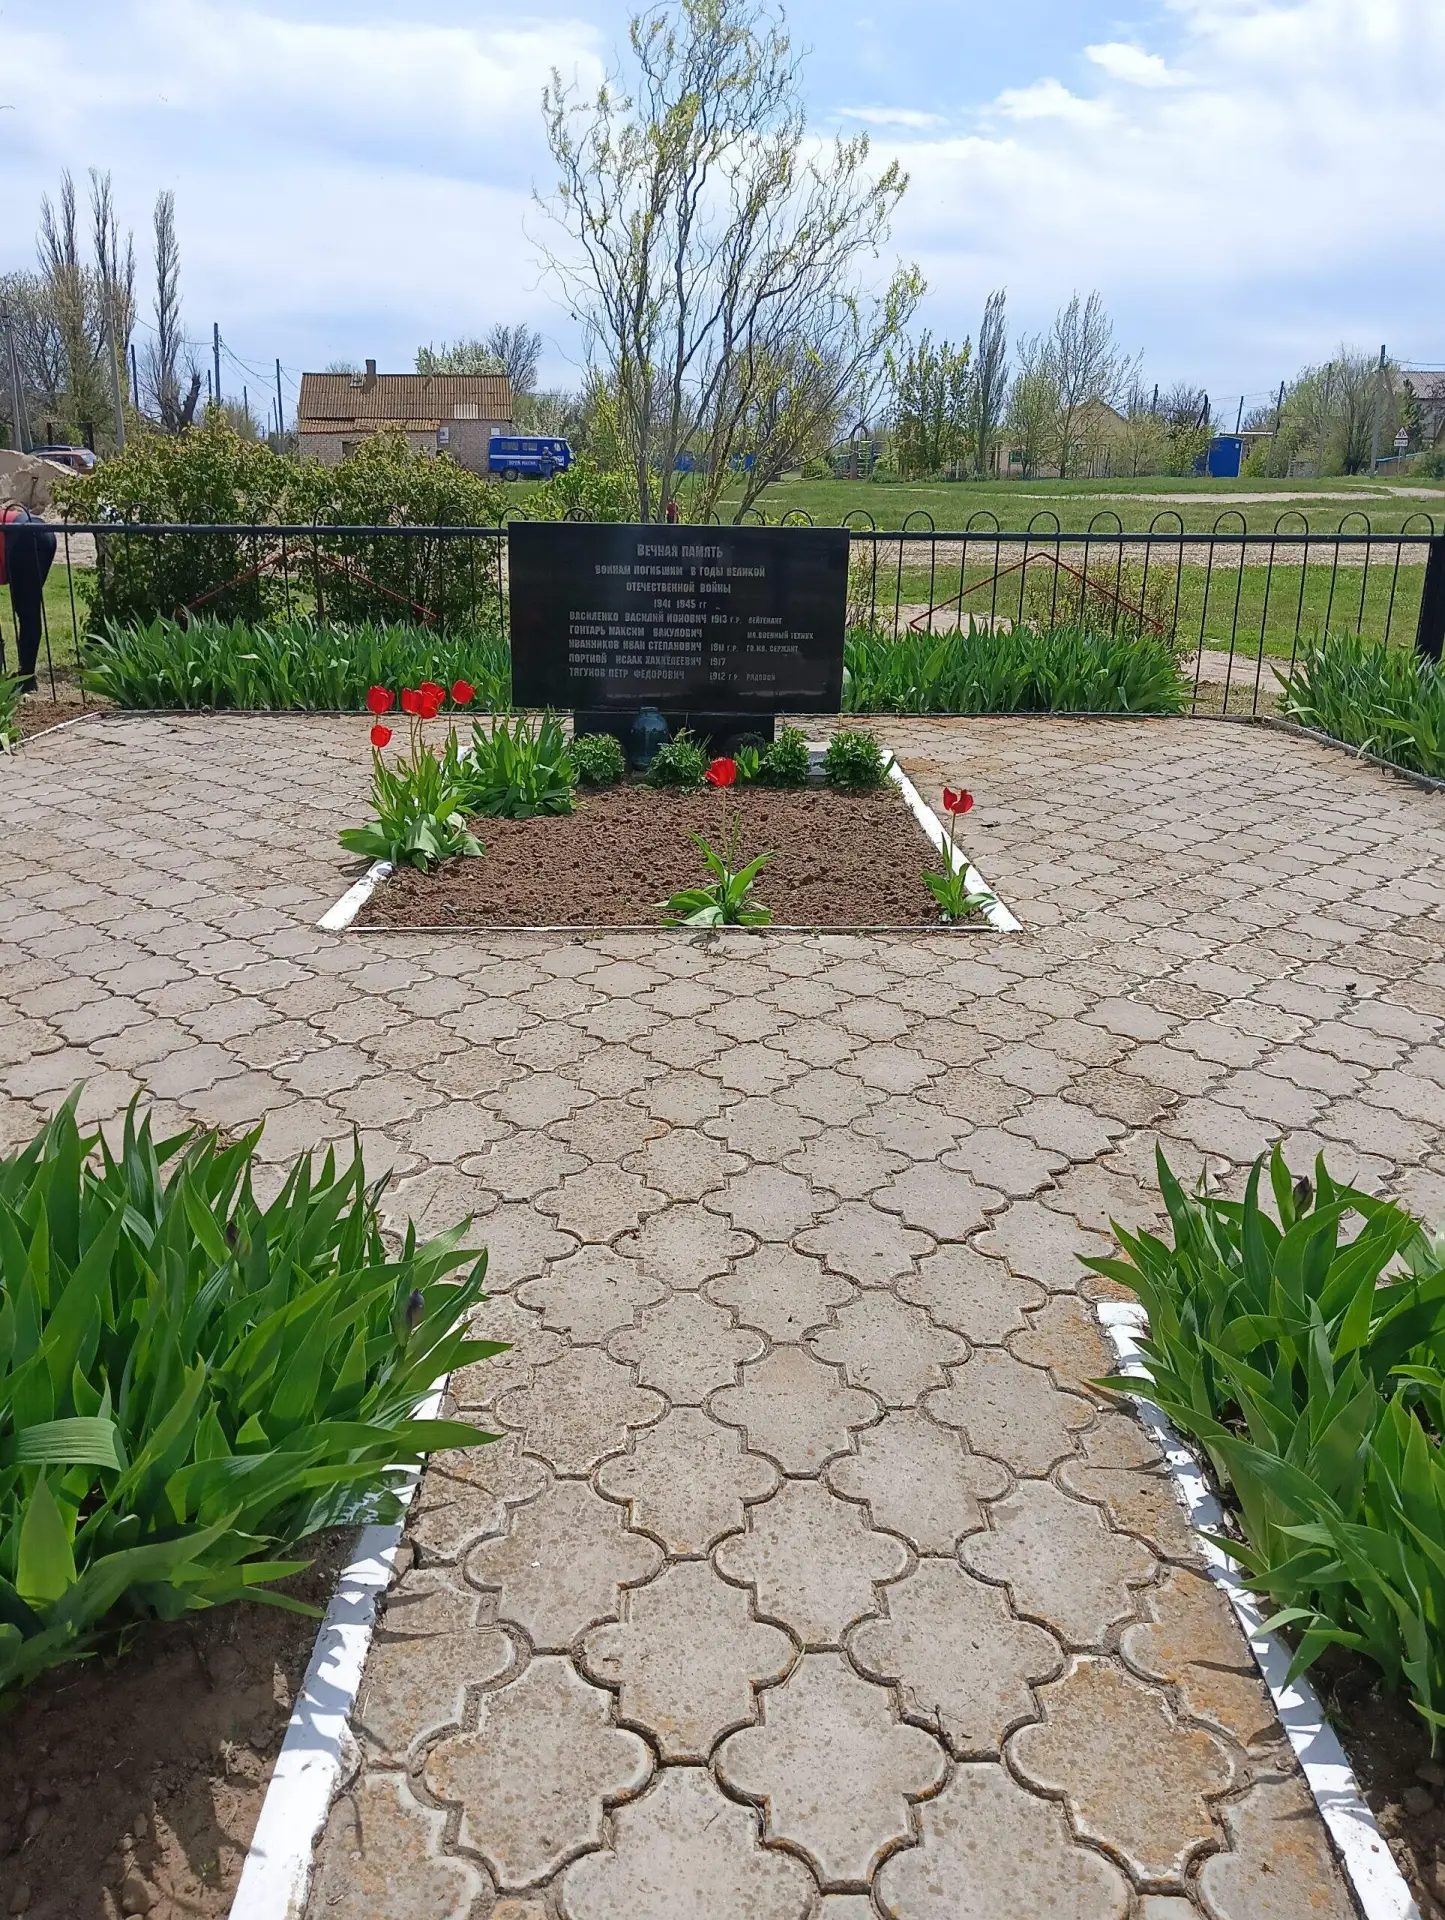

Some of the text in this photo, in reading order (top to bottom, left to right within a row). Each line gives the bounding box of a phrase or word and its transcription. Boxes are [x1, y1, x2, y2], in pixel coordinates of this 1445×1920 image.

[637, 544, 723, 558] ВЕЧНАЯ ПАМЯТЬ
[595, 565, 766, 578] ВОИНАМ ПОГИБШИМ В ГОДЫ ВЕЛИКОЙ
[626, 581, 731, 593] ОТЕЧЕСТВЕННОЙ ВОЙНЫ
[653, 599, 671, 609] 1941
[676, 599, 696, 609] 1945
[569, 611, 619, 621] ВАСИЛЕНКО
[624, 611, 664, 623] ВАСИЛИЙ
[711, 614, 728, 624] 1913
[569, 625, 605, 635] ГОНТАРЬ
[608, 626, 645, 637] МАКСИМ
[653, 627, 703, 638] ВАКУЛОВИЧ
[568, 639, 619, 650] ИВАННИКОВ
[623, 640, 645, 651] ИВАН
[648, 641, 702, 652] СТЕПАНОВИЧ
[769, 645, 798, 653] СЕРЖАНТ
[568, 652, 607, 664] ПОРТНОЙ
[616, 655, 642, 665] ИСААК
[710, 657, 726, 666] 1917
[569, 667, 605, 677] ТЯГУНОВ
[608, 668, 628, 678] ПЕТР
[633, 669, 685, 680] ФЕДОРОВИЧ
[709, 671, 725, 680] 1912
[746, 673, 776, 682] РЯДОВОЙ
